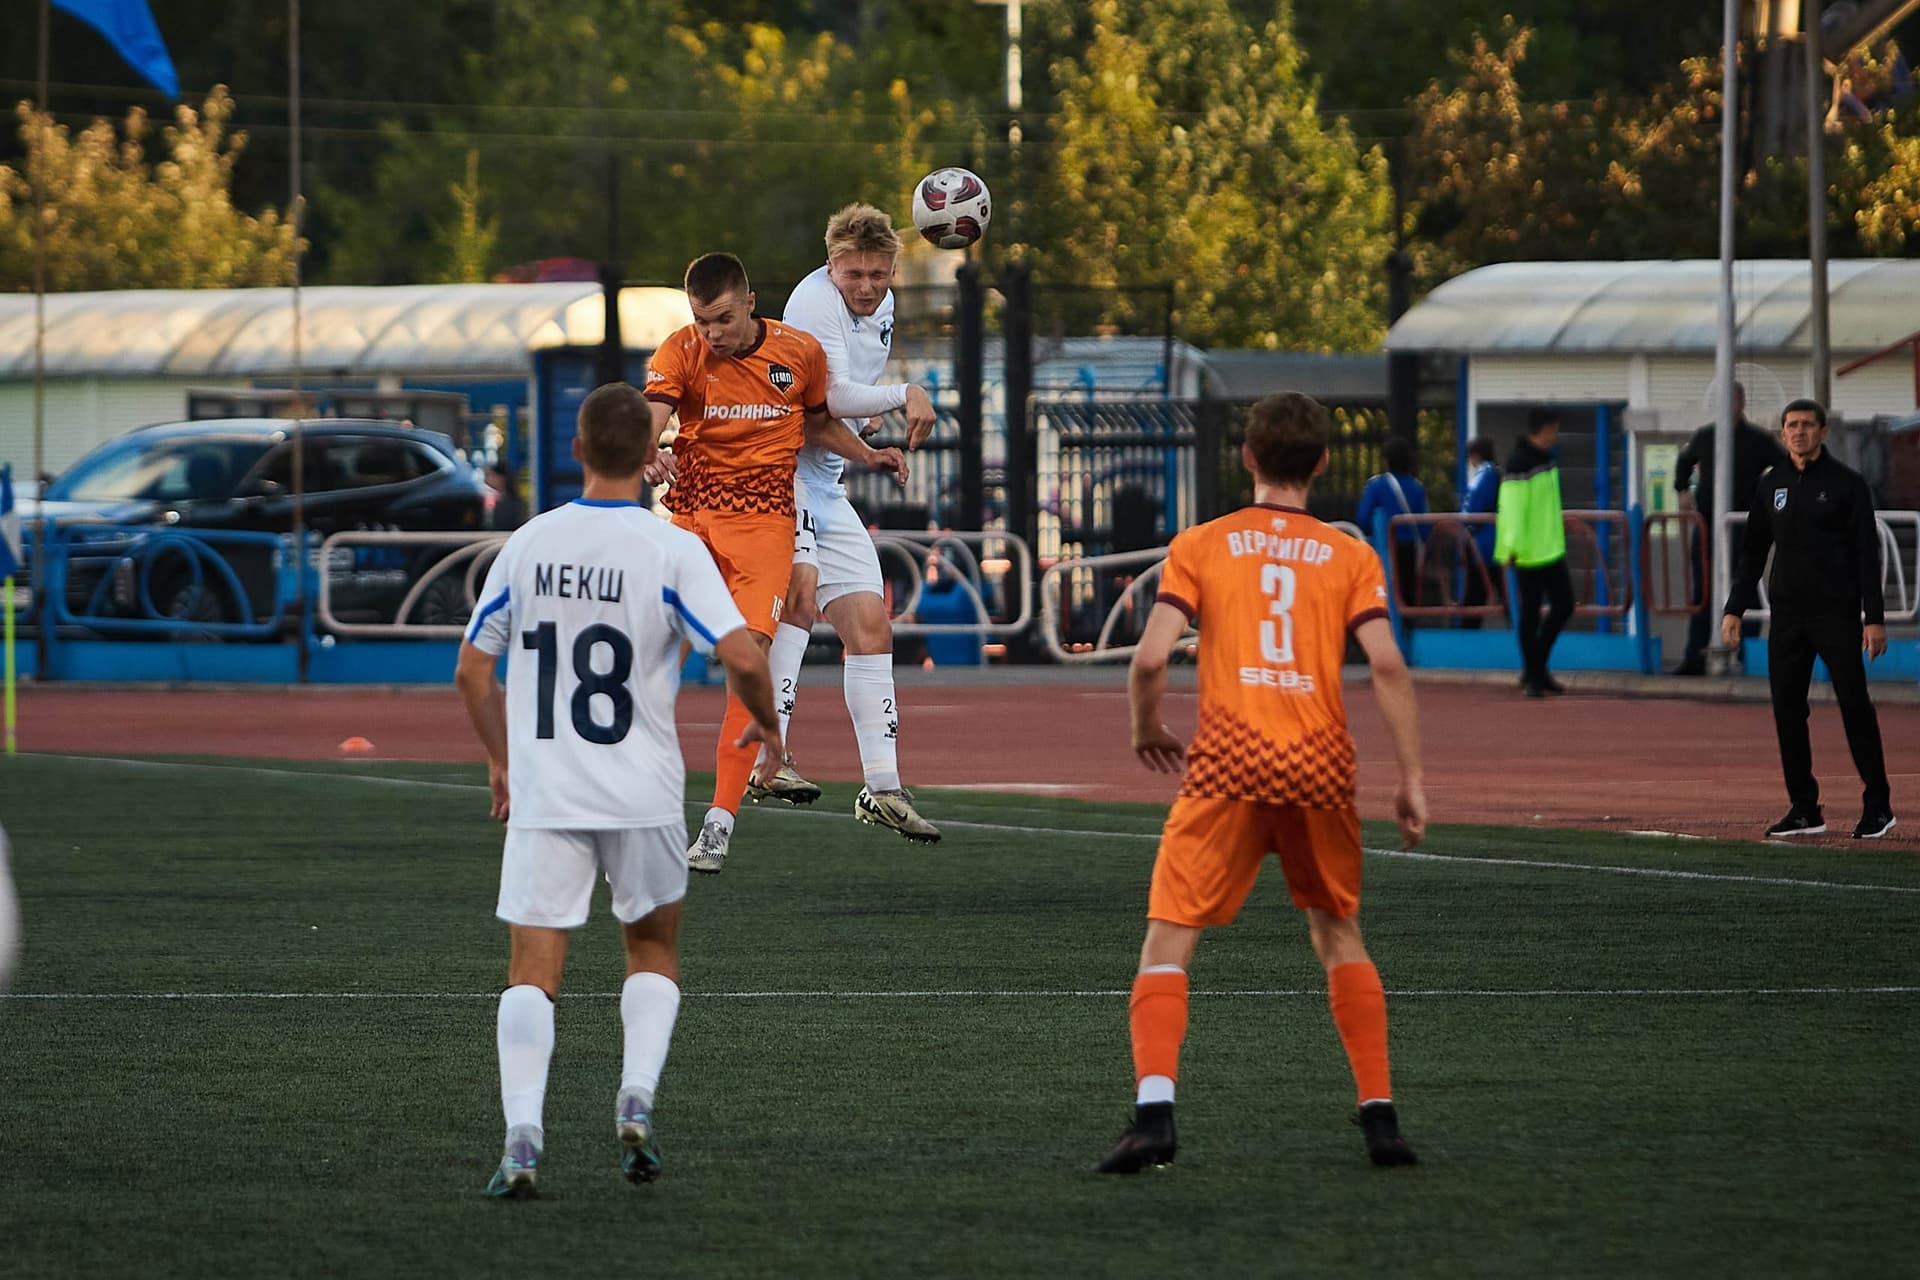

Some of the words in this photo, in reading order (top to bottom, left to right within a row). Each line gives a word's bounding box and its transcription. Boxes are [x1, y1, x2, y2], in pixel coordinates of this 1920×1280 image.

[770, 372, 791, 383] ТЕМП
[535, 563, 624, 603] МЕКШ
[1259, 563, 1296, 664] 3
[522, 621, 634, 745] 18
